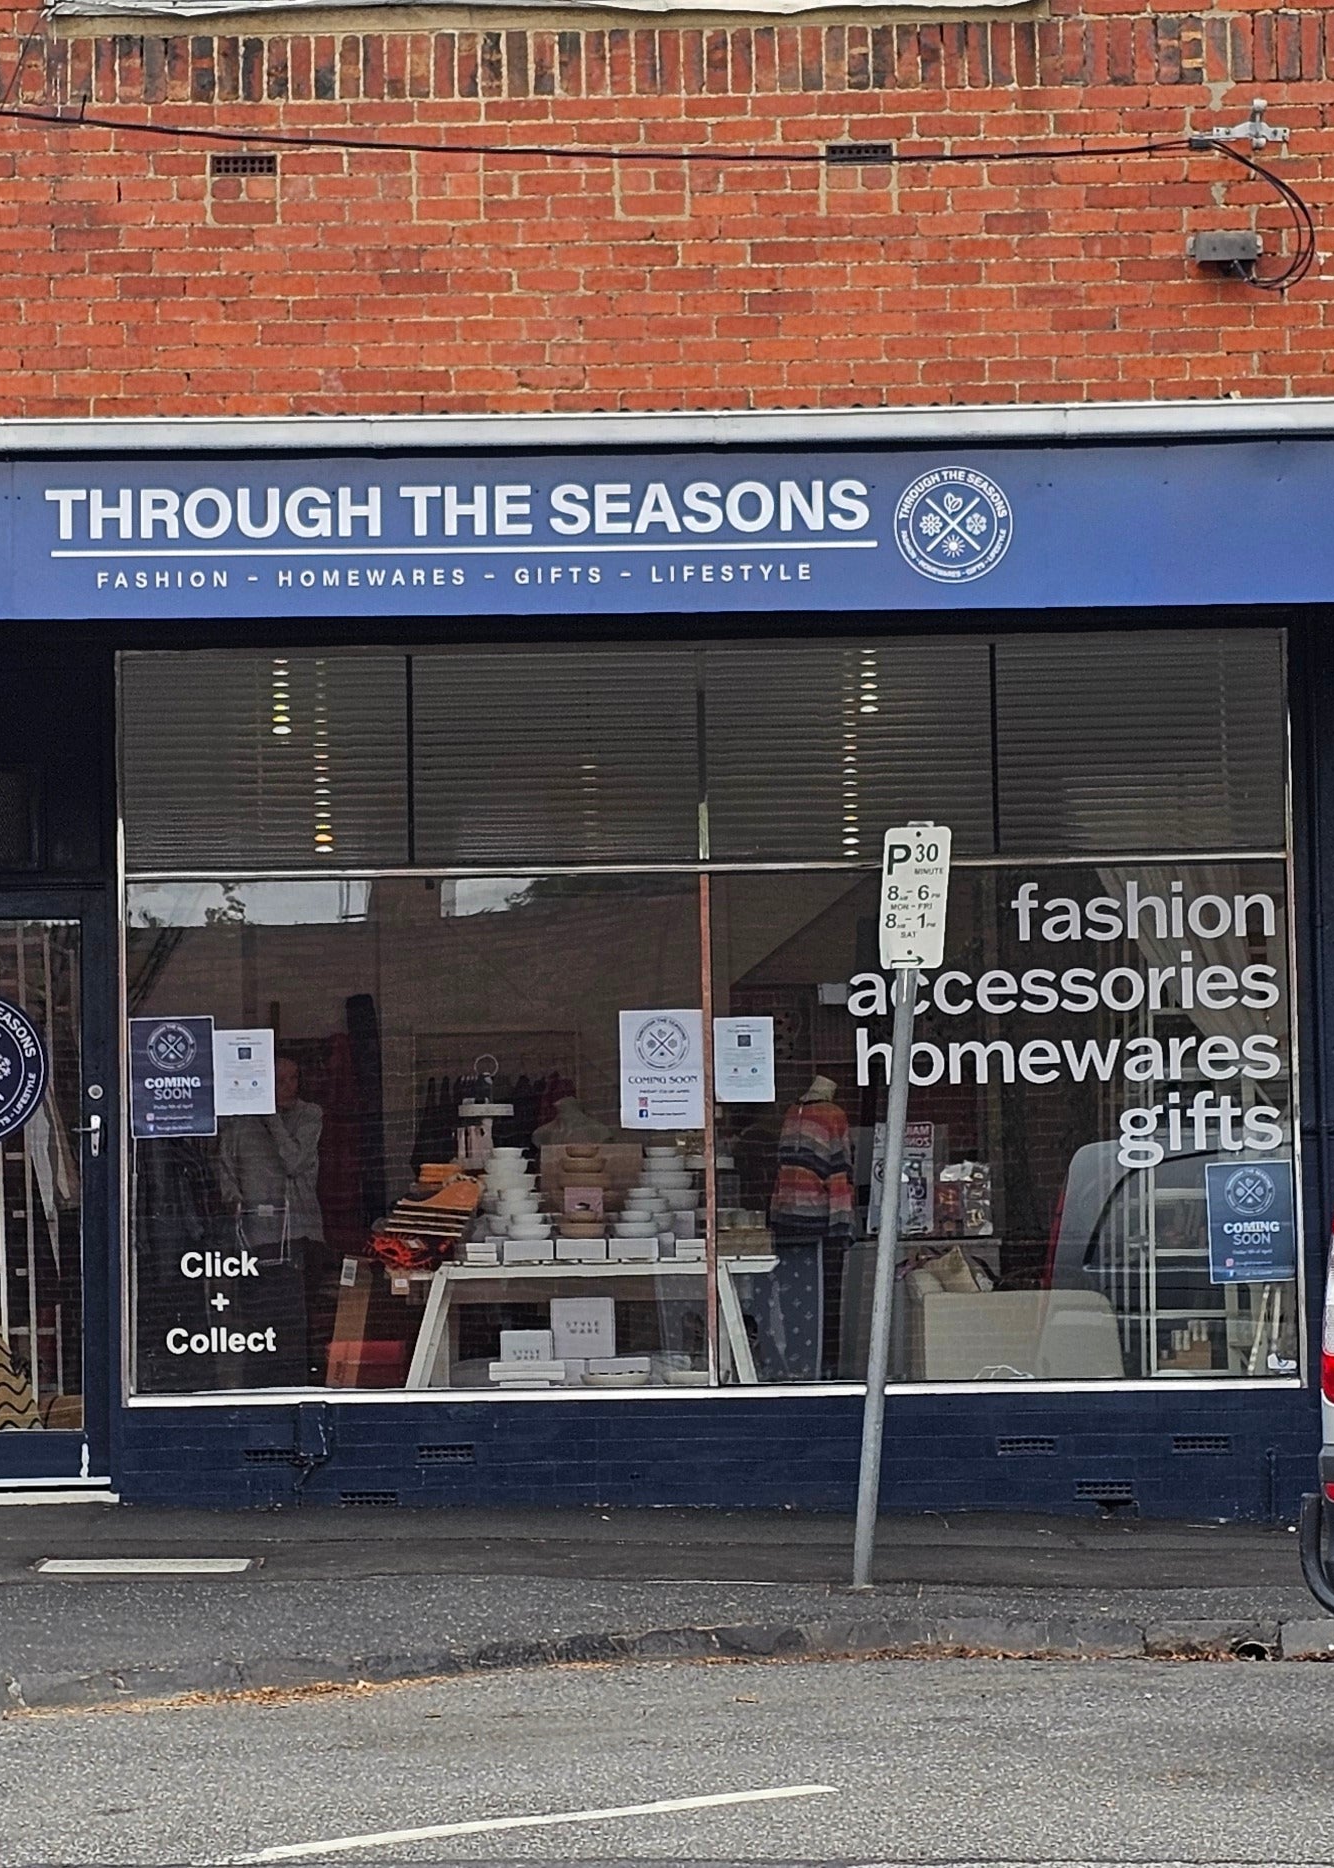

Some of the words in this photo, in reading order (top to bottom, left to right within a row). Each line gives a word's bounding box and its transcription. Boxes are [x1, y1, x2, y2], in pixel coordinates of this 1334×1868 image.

[898, 472, 940, 520] THROUGH
[941, 470, 966, 481] THE
[966, 472, 1008, 519] SEASONS
[44, 486, 382, 541] THROUGH
[399, 484, 533, 537] THE
[548, 479, 870, 536] SEASONS
[97, 570, 229, 589] FASHION
[278, 568, 466, 588] HOMEWARES
[514, 566, 602, 585] GIFTS
[651, 562, 812, 584] LIFESTYLE
[887, 844, 912, 876] P
[915, 843, 939, 863] 30
[914, 867, 944, 875] MINUTE
[1010, 880, 1276, 942] fashion
[856, 1027, 1283, 1087] homewares
[12, 1071, 37, 1117] LIFESTYLE
[144, 1075, 202, 1091] COMING
[153, 1087, 193, 1101] SOON
[628, 1074, 668, 1086] COMING
[668, 1074, 699, 1085] SOON
[1117, 1090, 1284, 1169] gifts
[1223, 1220, 1281, 1235] COMING
[1232, 1232, 1272, 1246] SOON
[180, 1250, 259, 1278] Click
[166, 1327, 277, 1355] Collect
